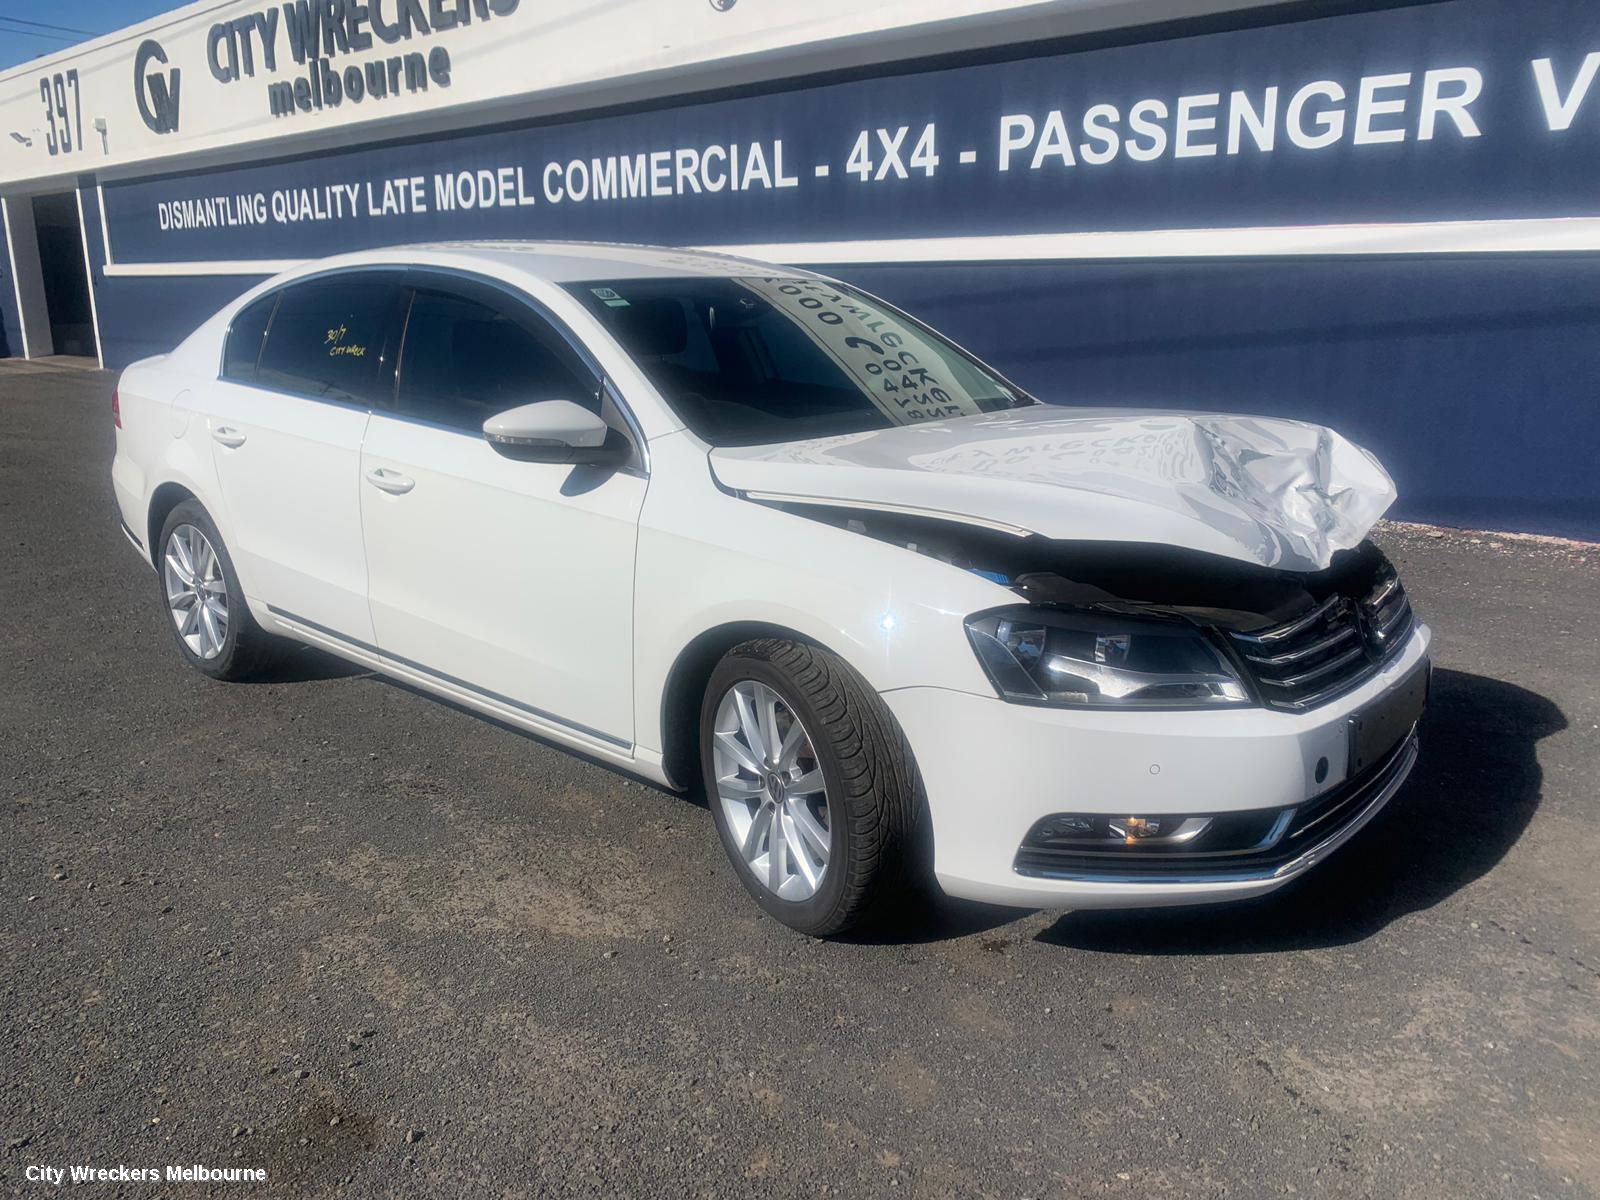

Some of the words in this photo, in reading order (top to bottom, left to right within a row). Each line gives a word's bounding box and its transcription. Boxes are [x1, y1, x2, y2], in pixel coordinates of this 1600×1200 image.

[207, 7, 279, 84] CITY
[283, 0, 520, 65] WRECK
[268, 46, 452, 118] melbourne
[40, 68, 83, 156] 397
[159, 195, 267, 230] DISMANTLING
[272, 184, 360, 224] QUALITY
[367, 177, 427, 216] LATE
[435, 167, 535, 211] MODEL
[543, 139, 799, 204] COMMERCIAL
[847, 123, 940, 182] 4X4
[998, 67, 1483, 172] PASSENGER
